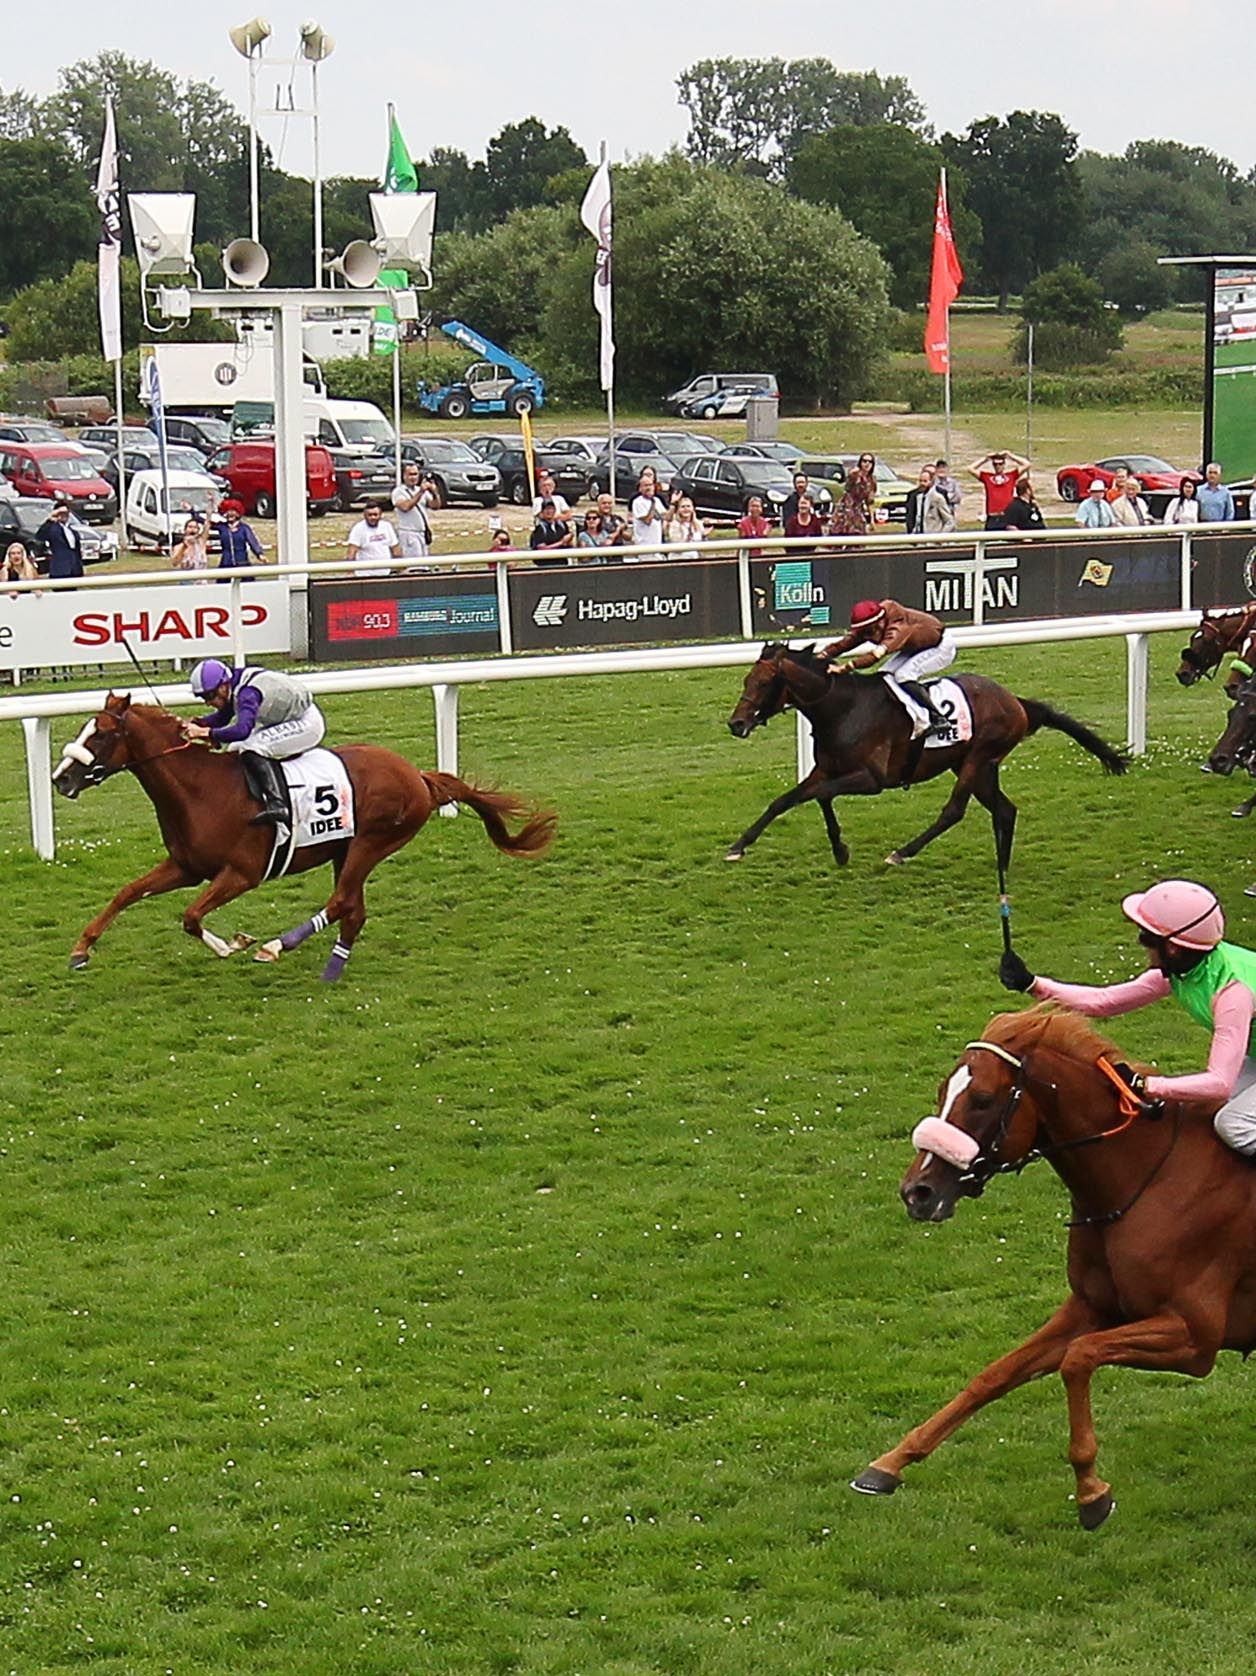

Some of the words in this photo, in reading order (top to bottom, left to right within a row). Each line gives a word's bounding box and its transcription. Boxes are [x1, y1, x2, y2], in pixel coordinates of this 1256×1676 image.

[578, 594, 691, 622] Hapag-Lloyd
[937, 727, 959, 741] DEE
[314, 784, 340, 816] 5
[310, 817, 345, 836] IDEE
